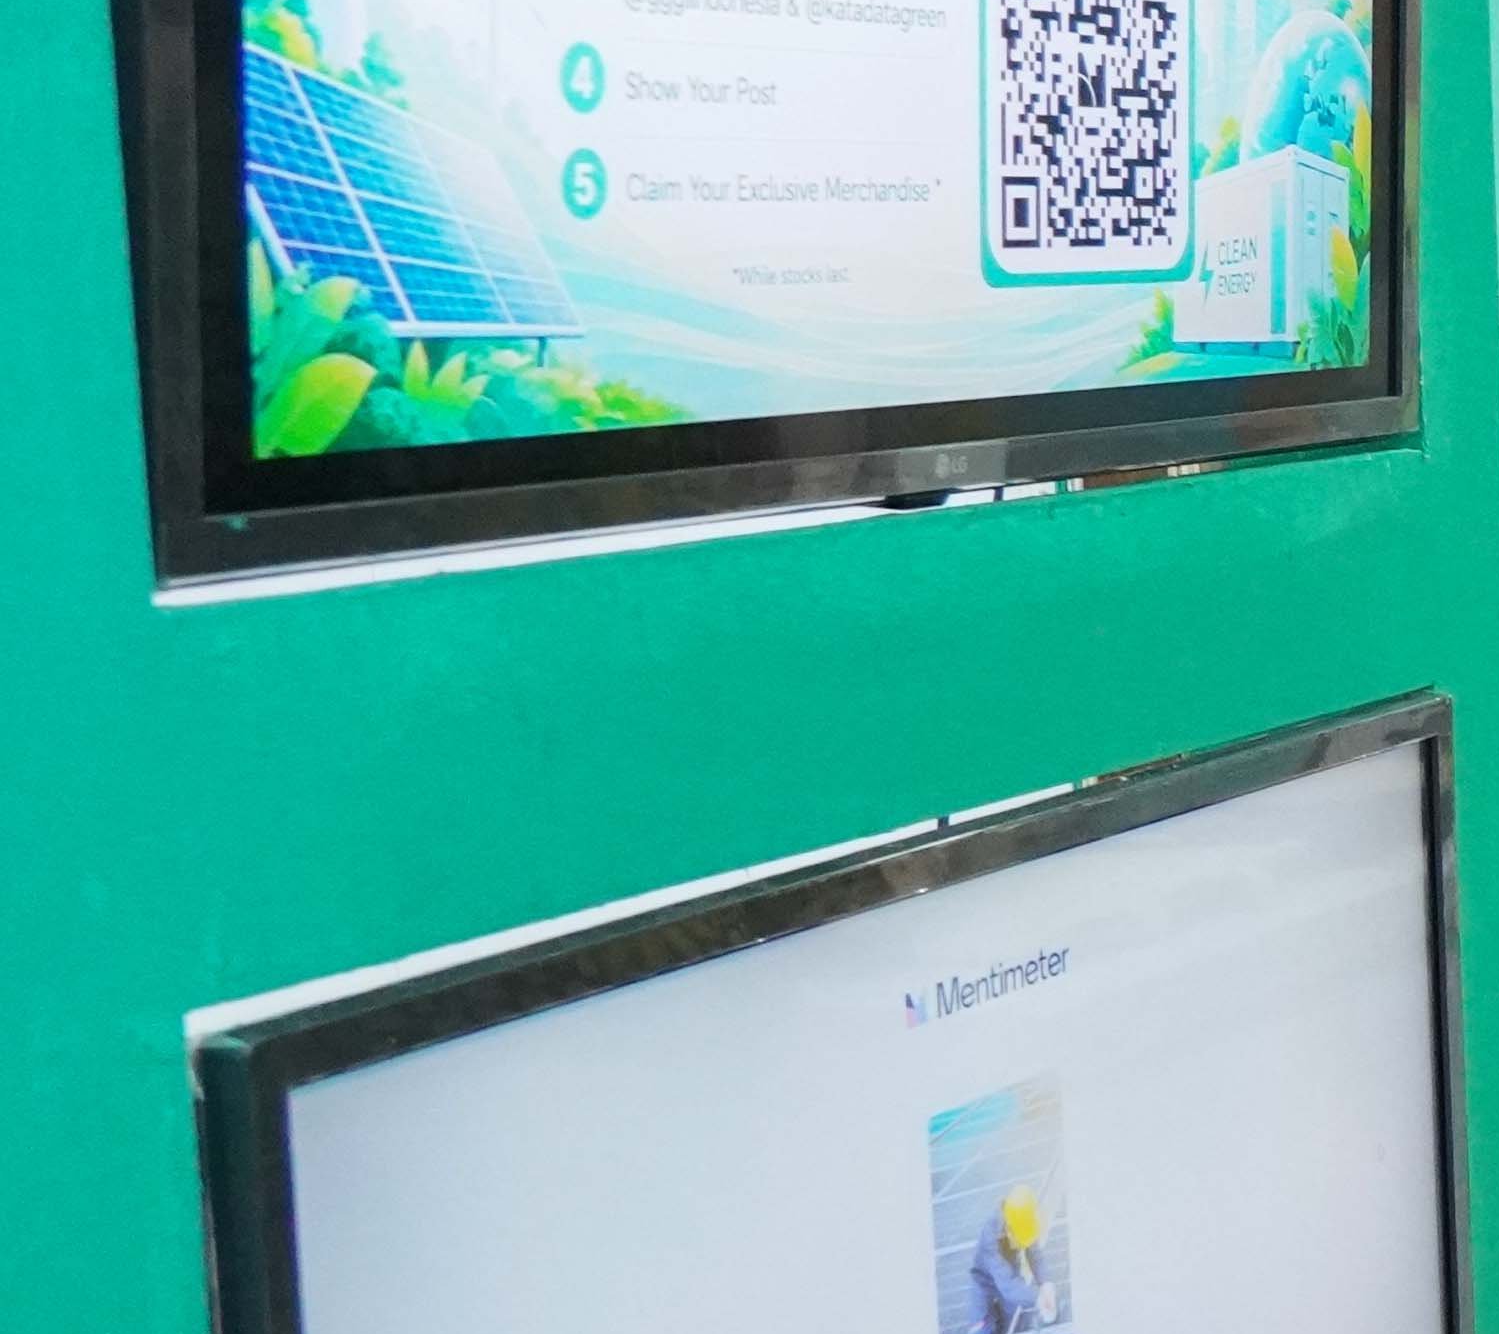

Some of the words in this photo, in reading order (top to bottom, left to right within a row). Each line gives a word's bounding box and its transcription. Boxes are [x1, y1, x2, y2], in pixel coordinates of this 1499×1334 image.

[569, 54, 594, 101] 4
[624, 70, 682, 101] Show
[689, 76, 731, 104] Your
[736, 77, 777, 106] Post
[571, 161, 596, 207] 5
[625, 173, 683, 203] Claim
[689, 174, 730, 203] Your
[736, 174, 819, 203] Exclusive
[1217, 236, 1258, 266] CLEAN
[1218, 271, 1257, 297] ENERGY
[936, 947, 1070, 1019] Mentimeter
